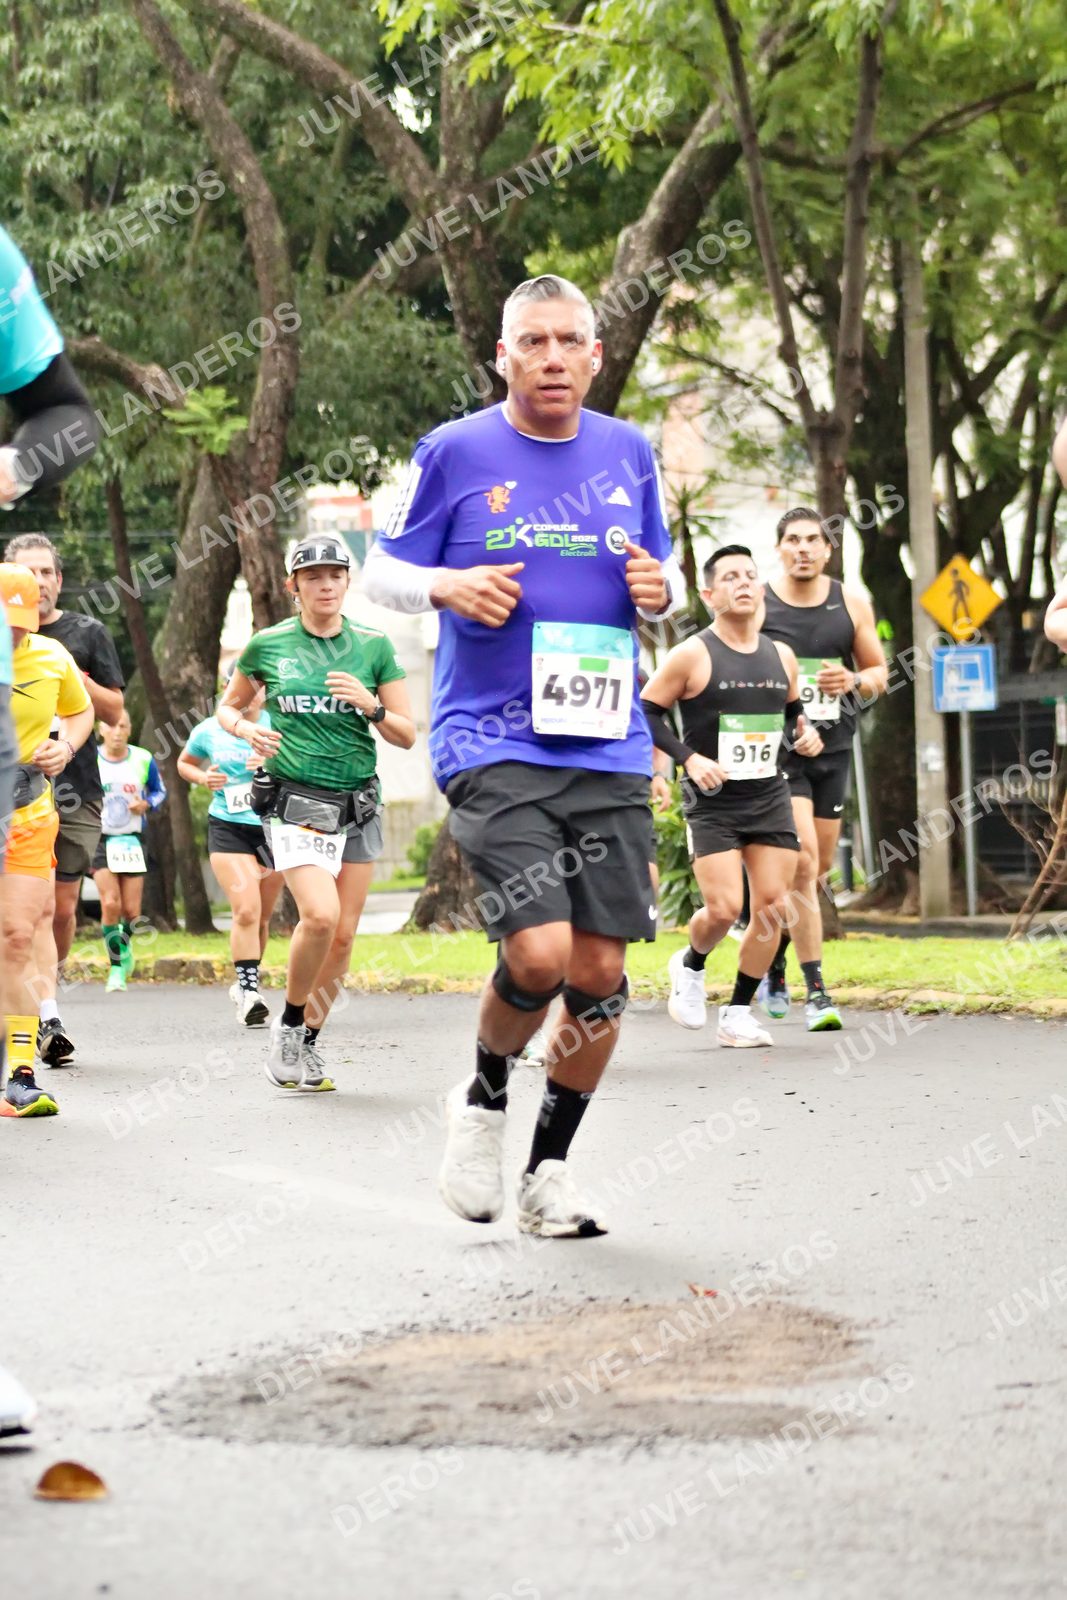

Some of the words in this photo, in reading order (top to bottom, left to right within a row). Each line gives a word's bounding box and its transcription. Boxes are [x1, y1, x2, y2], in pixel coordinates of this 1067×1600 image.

[534, 533, 572, 548] GDL
[542, 674, 621, 711] 4971
[732, 744, 771, 763] 916
[280, 834, 337, 860] 1388
